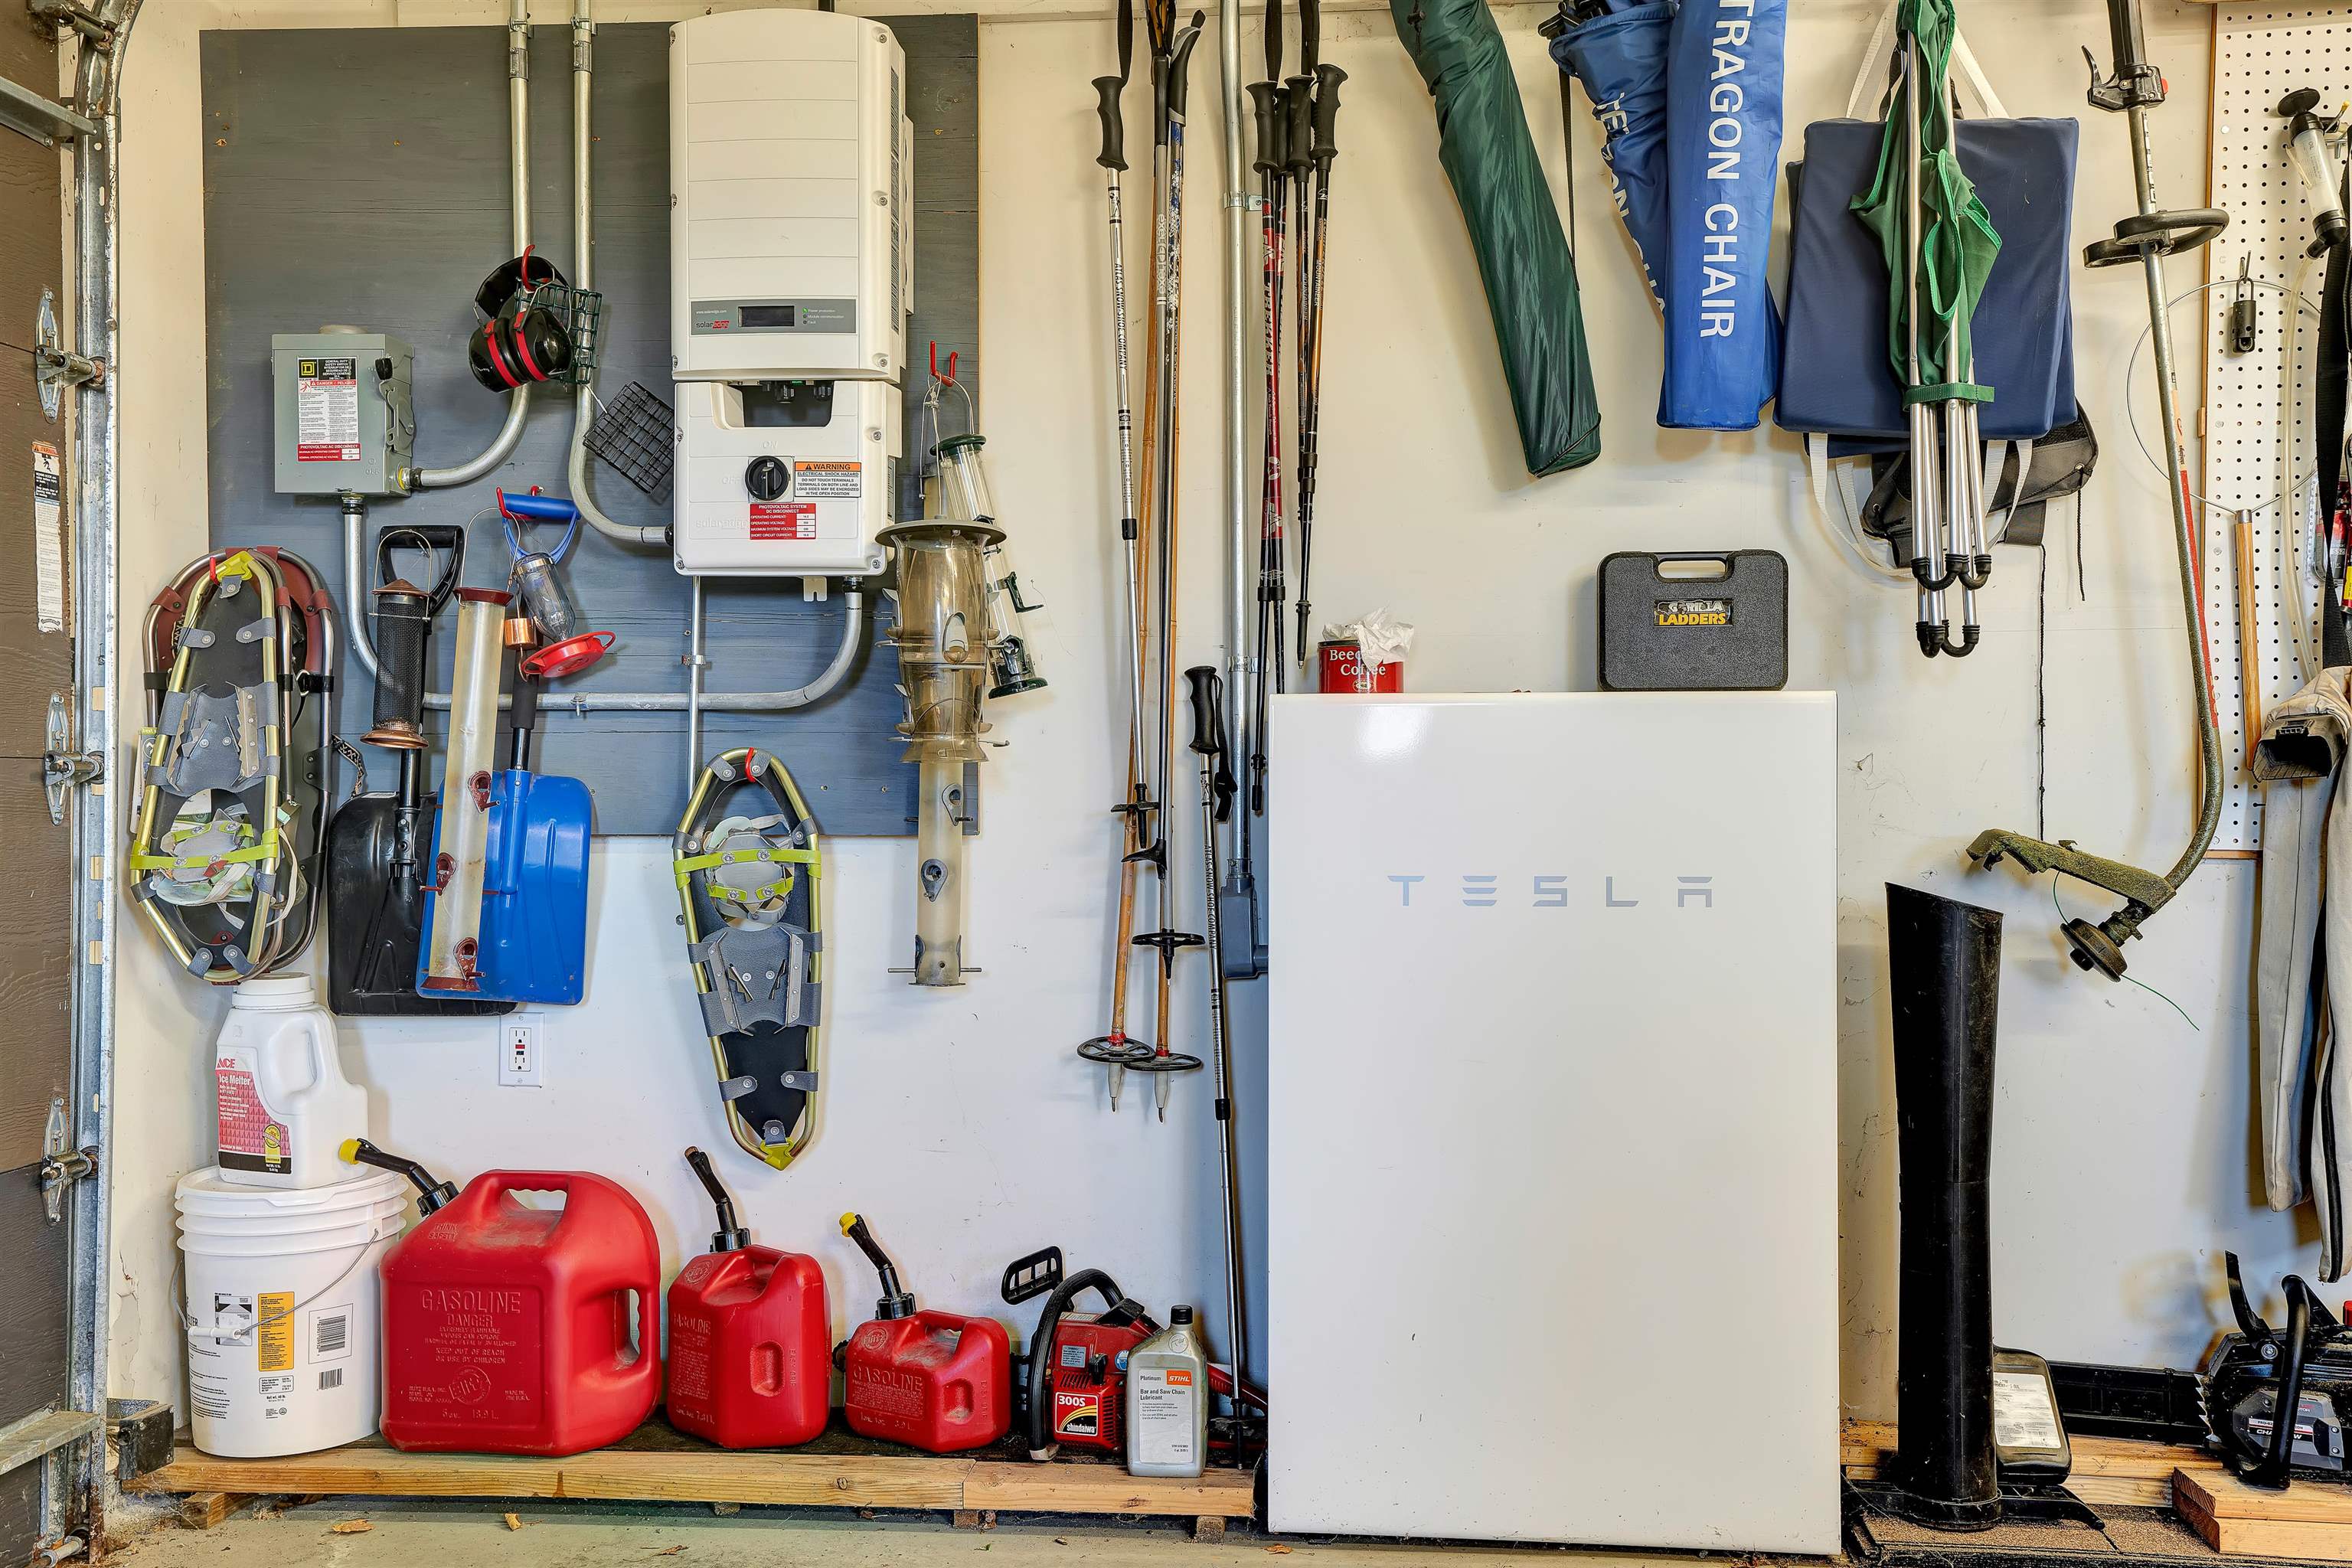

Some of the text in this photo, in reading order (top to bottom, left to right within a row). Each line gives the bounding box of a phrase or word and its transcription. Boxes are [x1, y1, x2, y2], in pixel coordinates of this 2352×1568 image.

[1700, 204, 1740, 338] CHAIR
[1314, 260, 1322, 306] MOUNTAINEER
[696, 319, 729, 331] solaredge
[1658, 612, 1726, 625] LADDERS
[1340, 665, 1387, 675] Cofee
[1387, 875, 1713, 908] TESLA
[1207, 914, 1217, 949] COMPANY
[217, 1057, 236, 1069] ACE
[219, 1073, 251, 1086] Ice Melter
[421, 1289, 521, 1314] GASOLINE
[446, 1313, 493, 1328] DANGER
[853, 1364, 923, 1392] GASOLINE
[1058, 1395, 1086, 1407] 300S
[1067, 1423, 1096, 1434] shindaiwa
